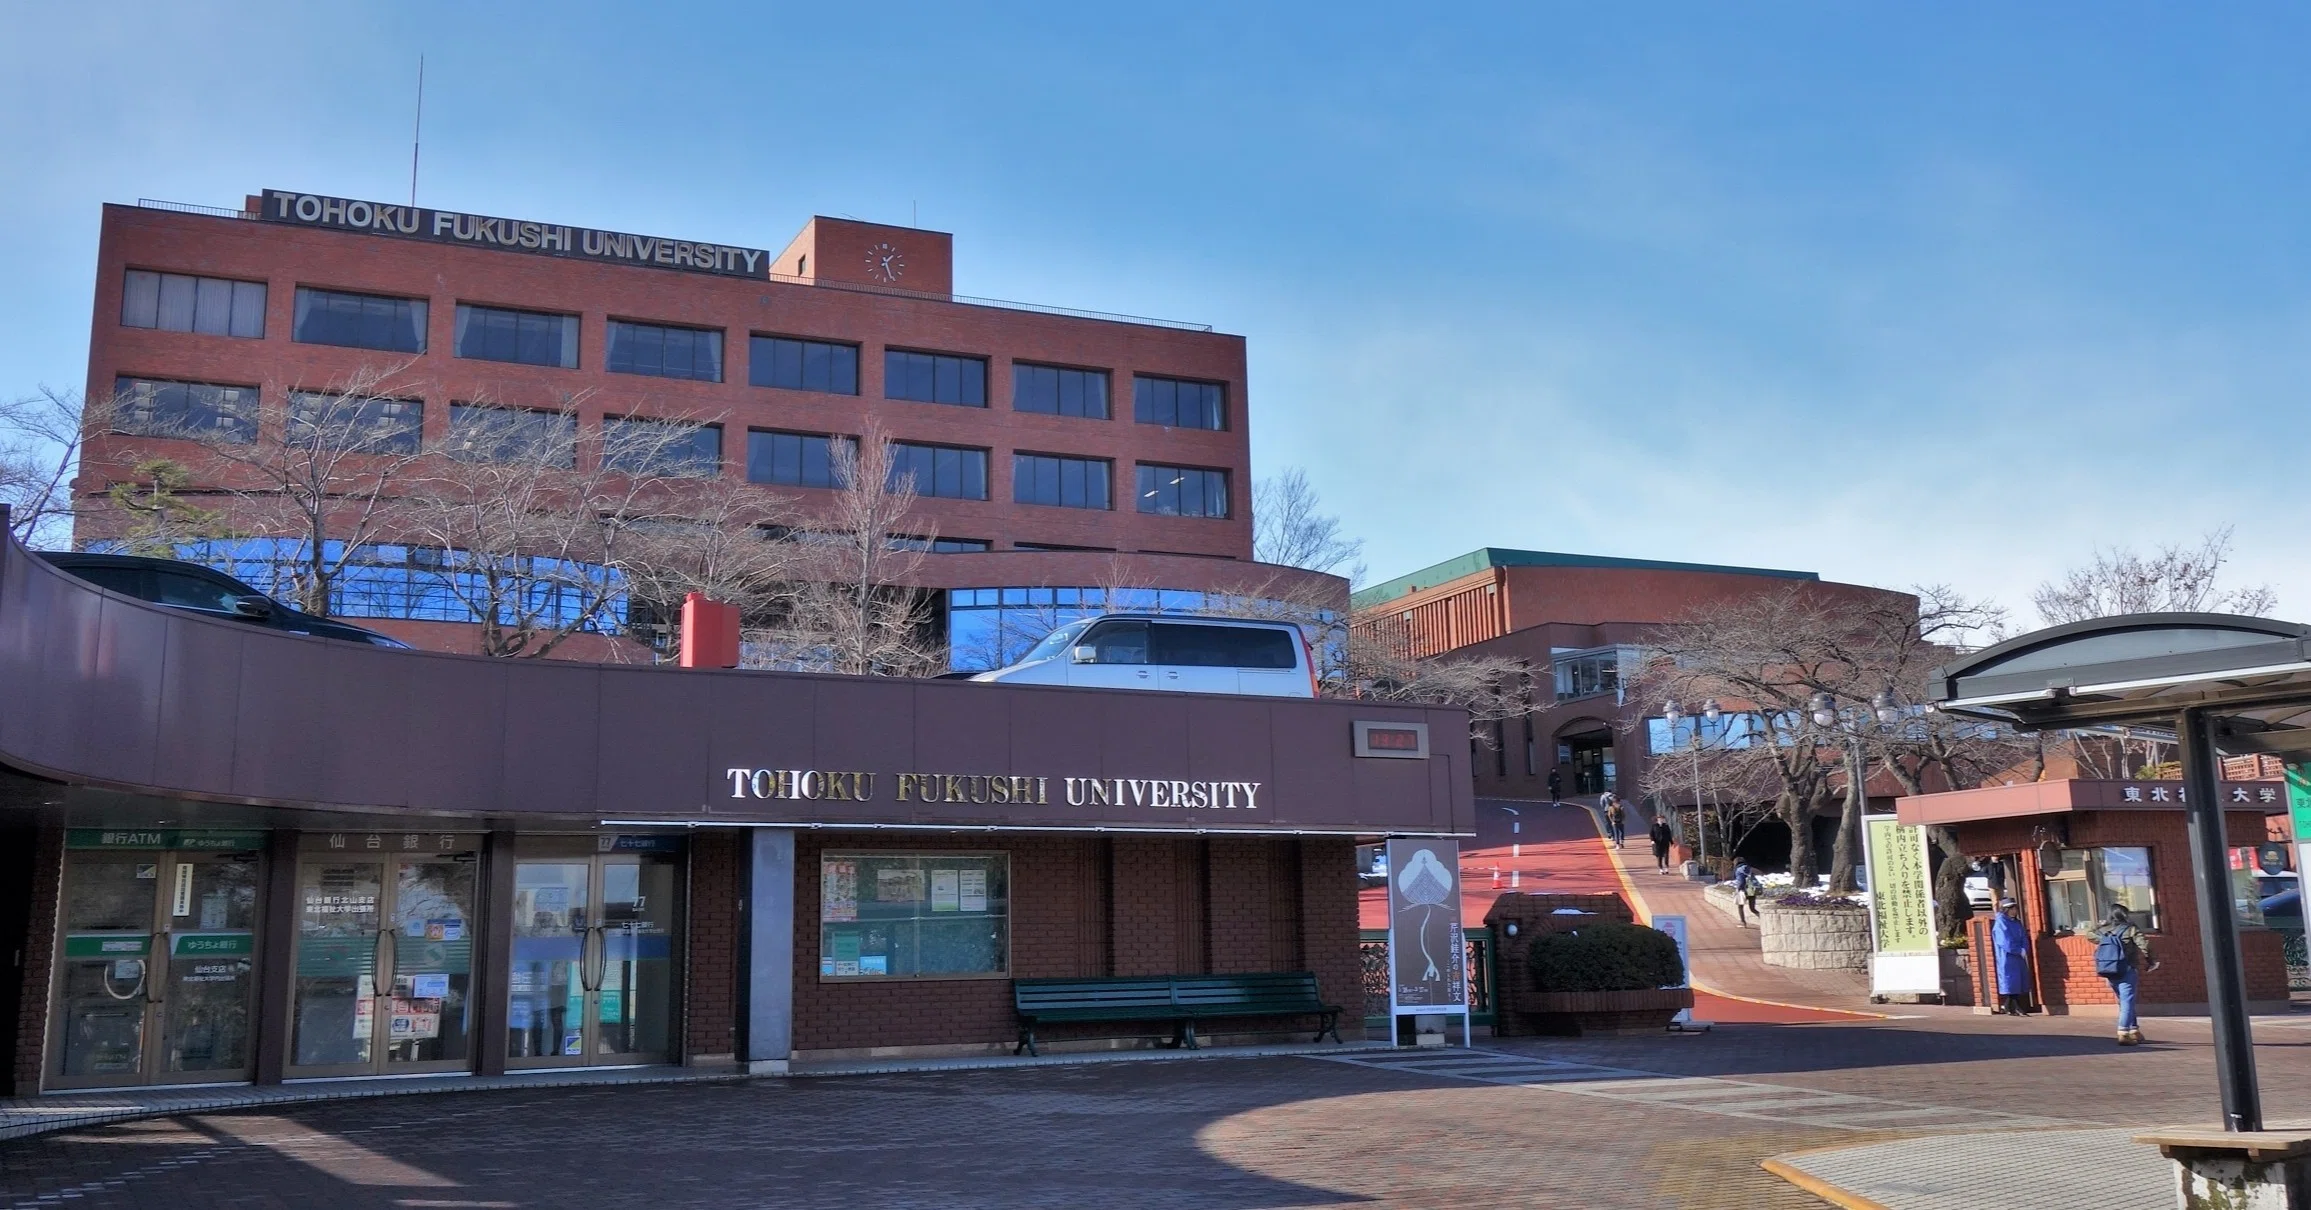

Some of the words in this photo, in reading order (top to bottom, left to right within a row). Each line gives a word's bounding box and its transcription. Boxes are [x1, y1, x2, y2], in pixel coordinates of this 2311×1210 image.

[272, 191, 420, 235] TOHOKU
[433, 211, 571, 251] FUKUSHI
[582, 229, 762, 273] UNIVERSITY
[727, 768, 876, 802] TOHOKU
[896, 772, 1049, 806] FUKUSHI
[1064, 777, 1261, 810] UNIVERSITY
[2123, 786, 2277, 803] 東北大学
[102, 832, 161, 845] 銀行ATM
[197, 838, 235, 847] ゆうちょ銀行
[329, 833, 456, 849] 仙台銀行
[620, 839, 656, 848] 七十七銀行
[631, 895, 647, 908] 77
[187, 939, 237, 950] ゆうちょ銀行
